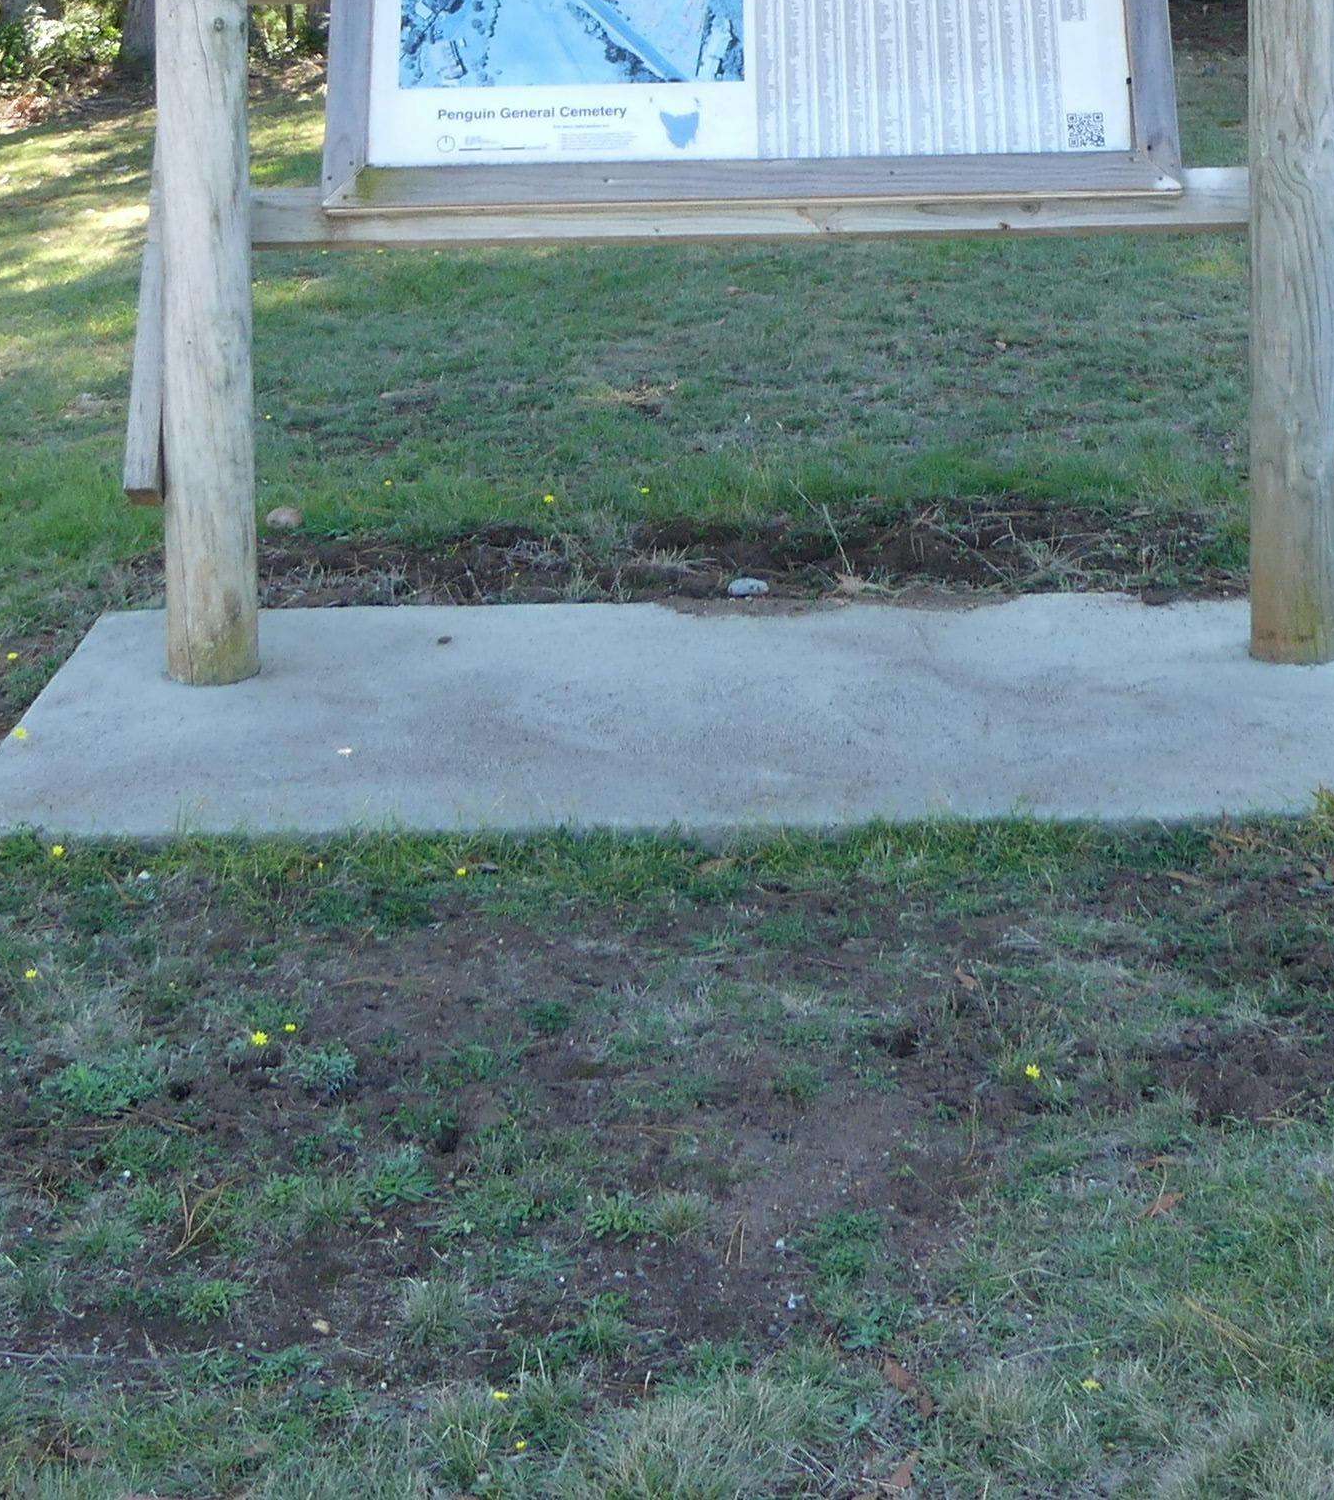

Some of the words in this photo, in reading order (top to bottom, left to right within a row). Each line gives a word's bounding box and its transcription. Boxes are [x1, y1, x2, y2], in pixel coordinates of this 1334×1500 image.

[438, 108, 495, 122] Penguin
[500, 107, 555, 119] General
[560, 106, 627, 119] Cemetery
